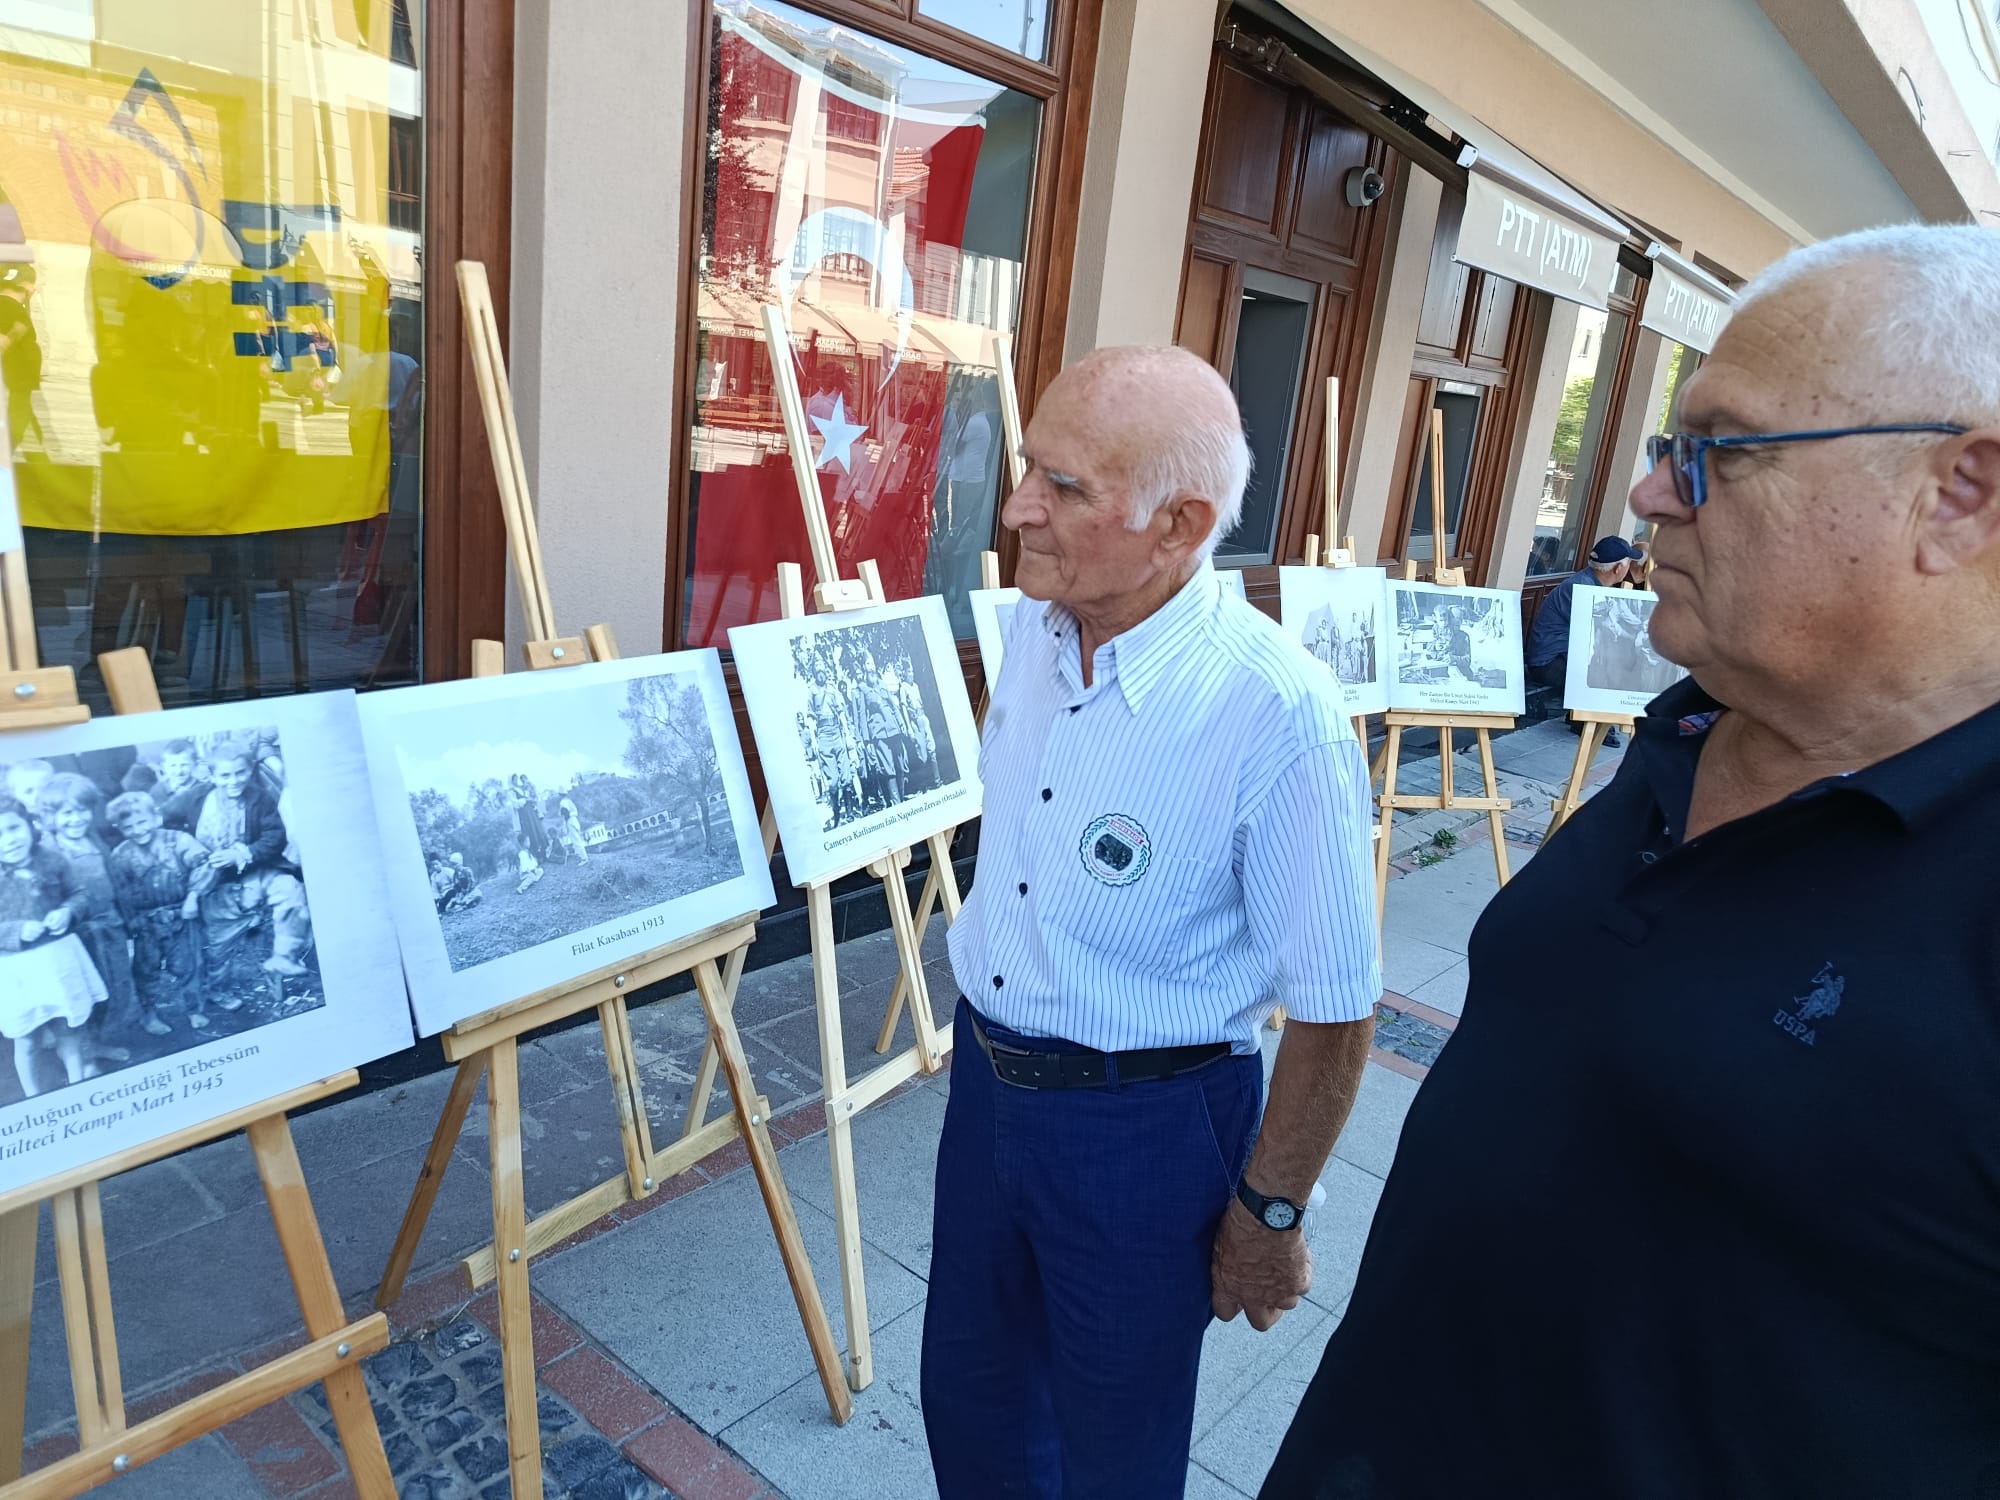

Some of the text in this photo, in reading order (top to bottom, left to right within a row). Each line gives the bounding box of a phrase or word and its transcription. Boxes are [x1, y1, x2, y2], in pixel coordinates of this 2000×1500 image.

[1497, 199, 1593, 290] PTT (ATM)
[1663, 280, 1719, 345] PTT (ATM)
[824, 835, 853, 852] Çamerya
[897, 807, 924, 821] Napoleon
[924, 800, 941, 811] Zervas
[571, 914, 665, 956] Filat Kasabası 1913
[1773, 1008, 1816, 1046] USPA
[0, 1044, 260, 1137] uzluğun Getirdiği Tebessüm
[63, 1110, 124, 1139] Kampı
[130, 1091, 175, 1117] Mart
[182, 1072, 223, 1098] 1945
